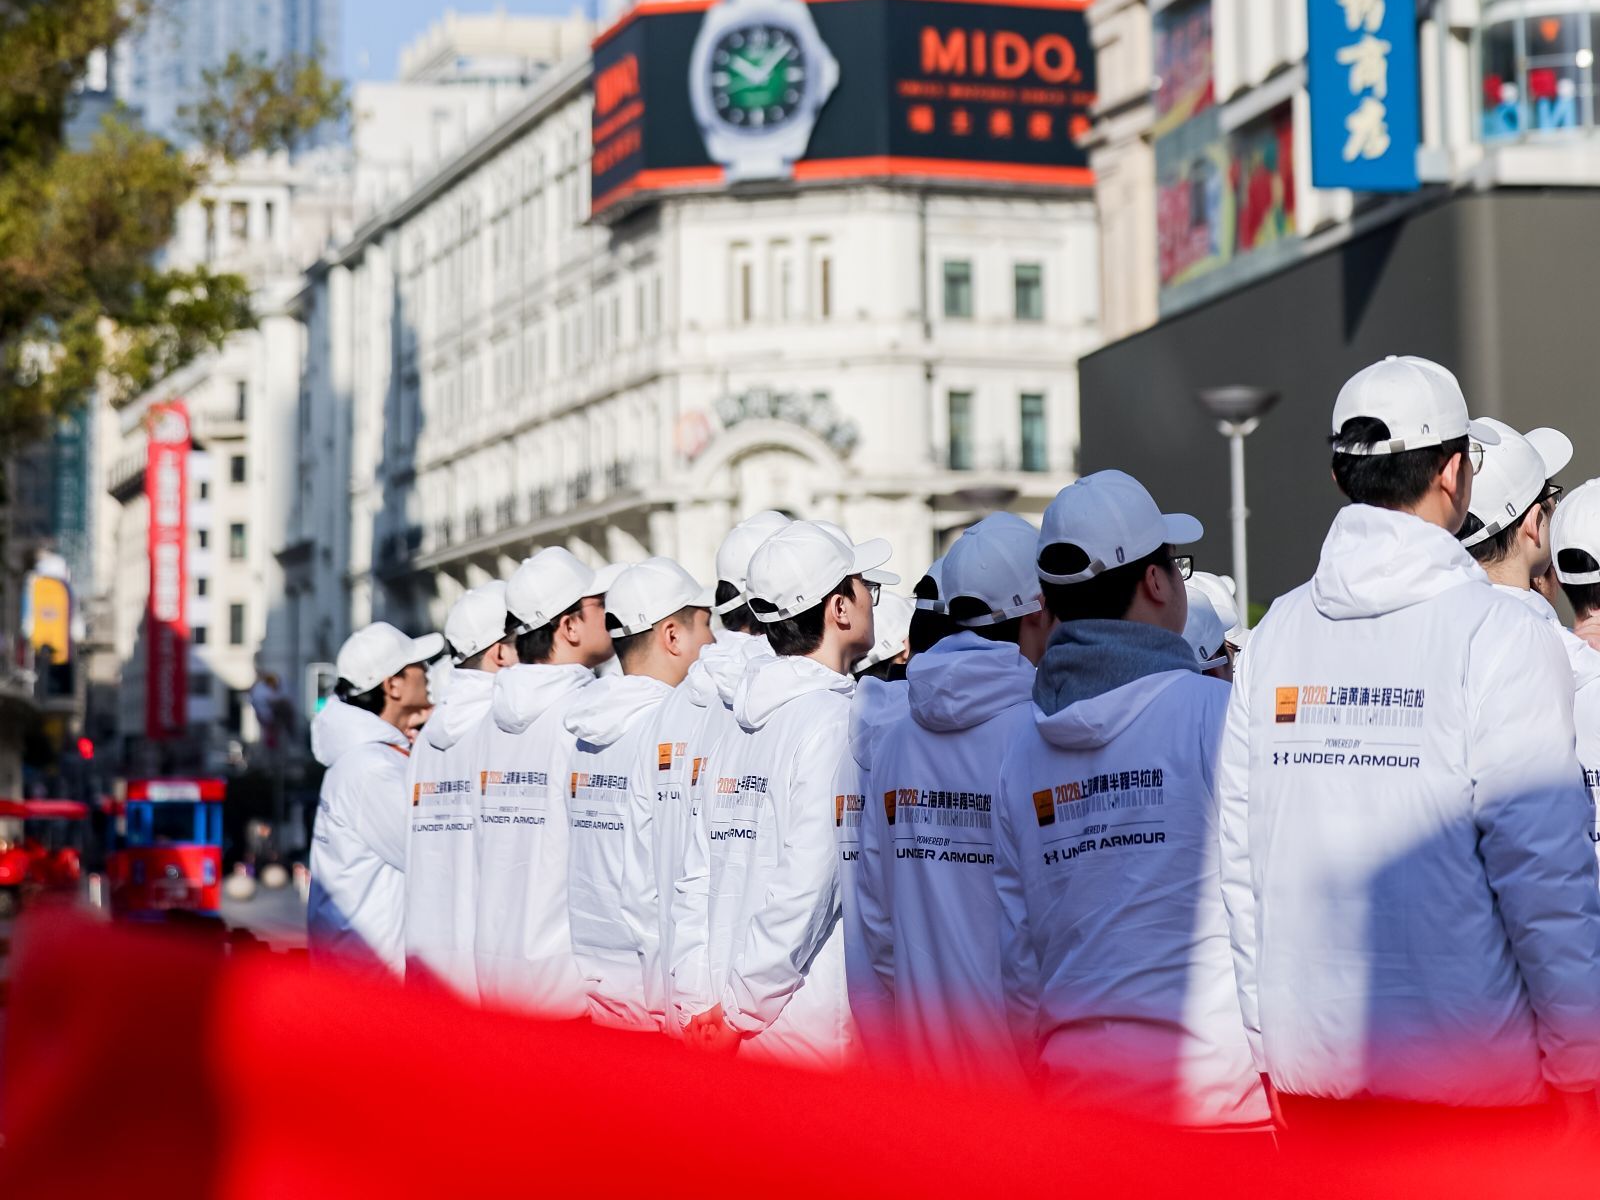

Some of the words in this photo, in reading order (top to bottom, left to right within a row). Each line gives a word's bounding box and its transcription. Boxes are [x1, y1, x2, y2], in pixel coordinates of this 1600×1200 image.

[1293, 752, 1345, 765] UNDER
[1347, 754, 1420, 768] ARMOUR
[512, 816, 545, 825] ARMOUR
[1099, 832, 1166, 850] ARMOUR
[938, 851, 995, 865] ARMOUR
